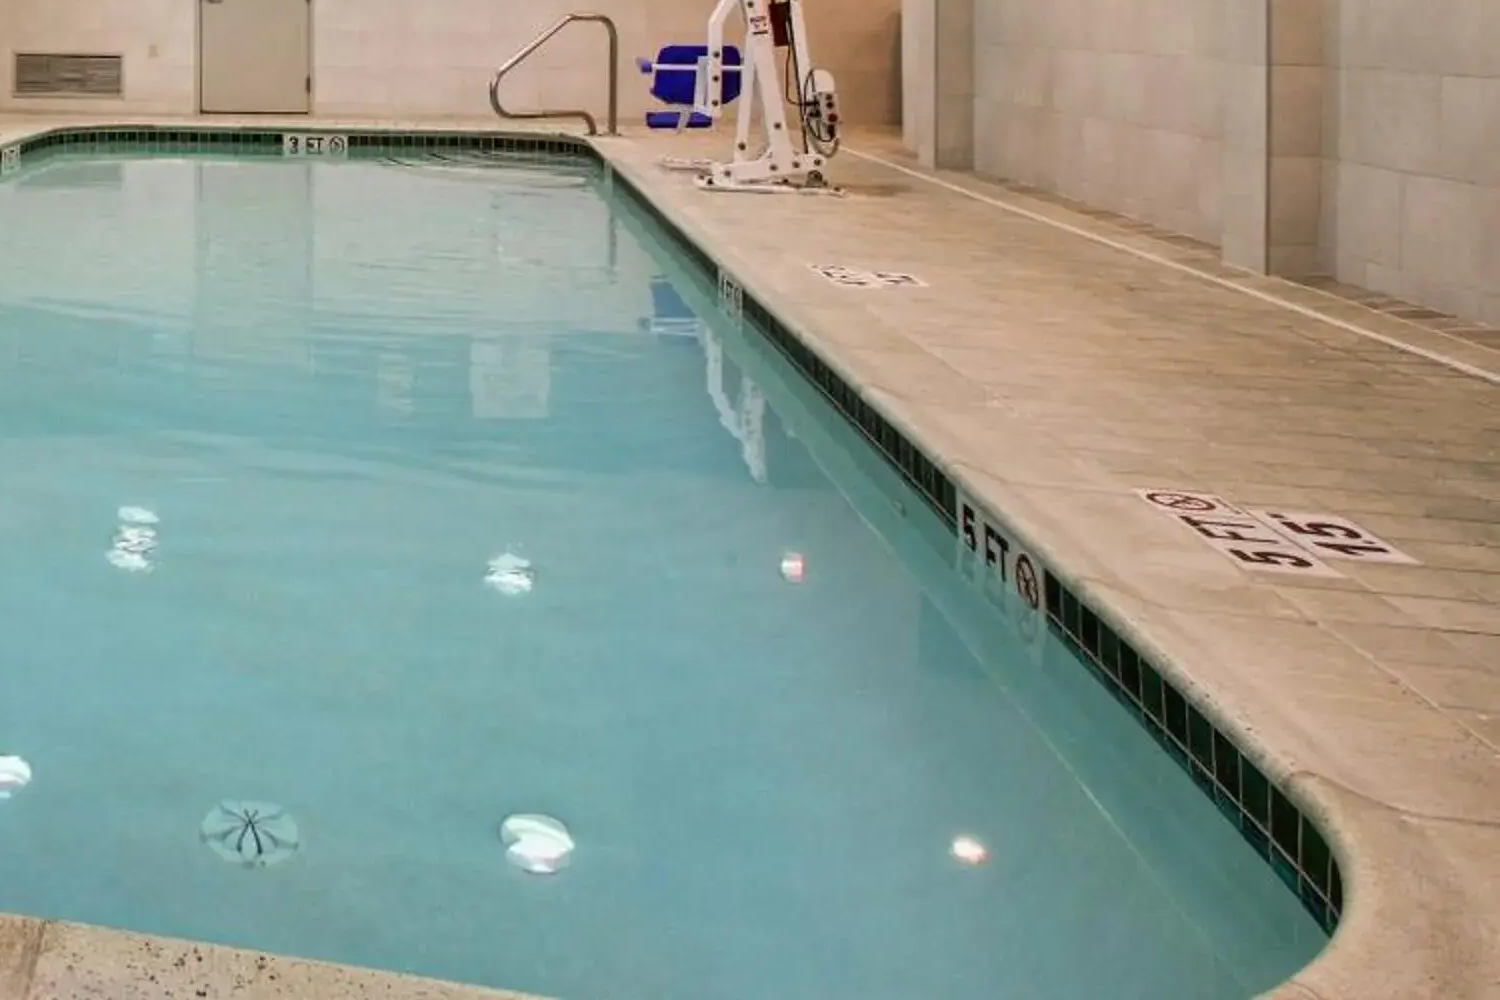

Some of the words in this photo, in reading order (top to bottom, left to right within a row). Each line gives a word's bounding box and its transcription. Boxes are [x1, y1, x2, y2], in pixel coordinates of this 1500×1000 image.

[962, 503, 977, 552] 5
[984, 521, 1010, 583] FT
[1229, 548, 1313, 568] 5
